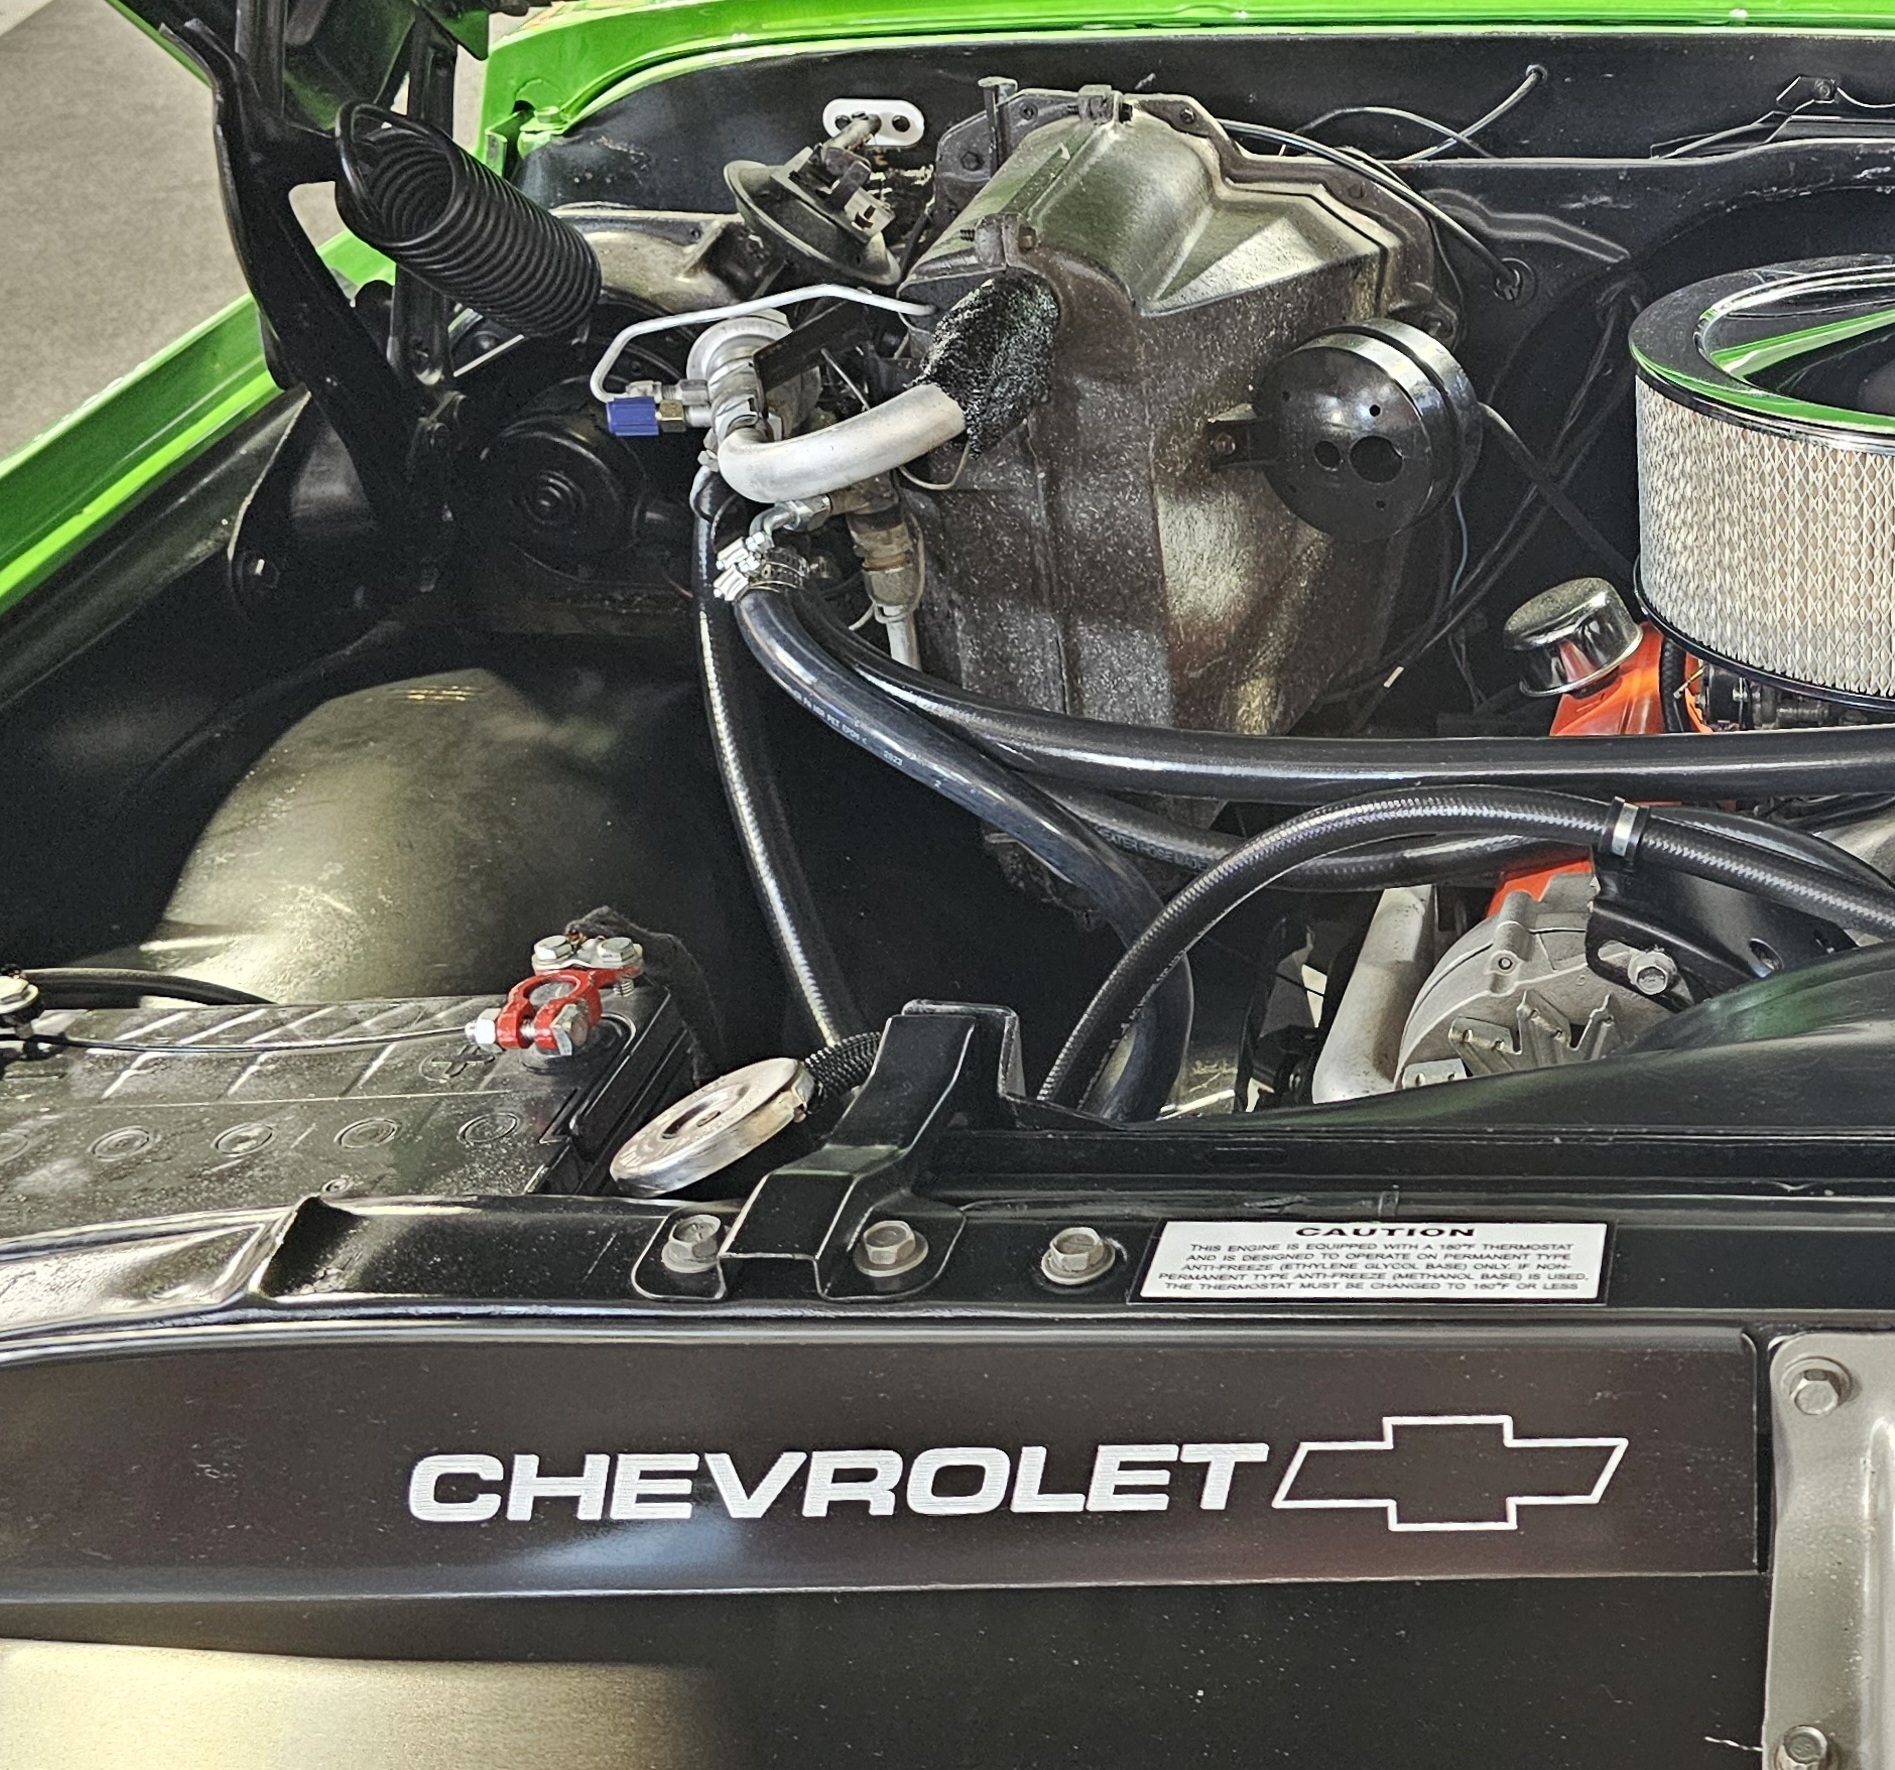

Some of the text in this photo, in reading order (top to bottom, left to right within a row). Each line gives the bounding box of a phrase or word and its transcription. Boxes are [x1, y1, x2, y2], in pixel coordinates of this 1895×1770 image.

[1295, 1226, 1476, 1238] CAUTION
[1189, 1243, 1223, 1252] THIS
[1226, 1243, 1281, 1252] ENGINE
[1285, 1242, 1300, 1251] IS
[1305, 1242, 1379, 1251] EQUIPPED
[1382, 1243, 1419, 1251] WITH
[1422, 1243, 1434, 1251] A
[1481, 1243, 1575, 1251] THERMOSTAT
[1185, 1252, 1571, 1262] AND IS DESIGNED TO OPERATE ON PERMANENT TYPE
[1180, 1263, 1275, 1272] ANTI-FREEZE
[1363, 1262, 1420, 1270] GLYCOL
[1517, 1263, 1531, 1271] IF
[1157, 1272, 1249, 1281] PERMANENT
[1253, 1272, 1290, 1281] TYPE
[1292, 1271, 1387, 1280] ANTI-FREEZE
[1527, 1273, 1542, 1281] IS
[1164, 1281, 1194, 1291] THE
[1198, 1281, 1295, 1291] THERMOSTAT
[1298, 1281, 1341, 1290] MUST
[1344, 1281, 1365, 1290] BE
[1369, 1282, 1442, 1290] CHANGED
[1446, 1282, 1467, 1291] TO
[1515, 1282, 1538, 1291] OR
[1541, 1282, 1579, 1291] LESS
[407, 1443, 1270, 1522] CHEVROLET
